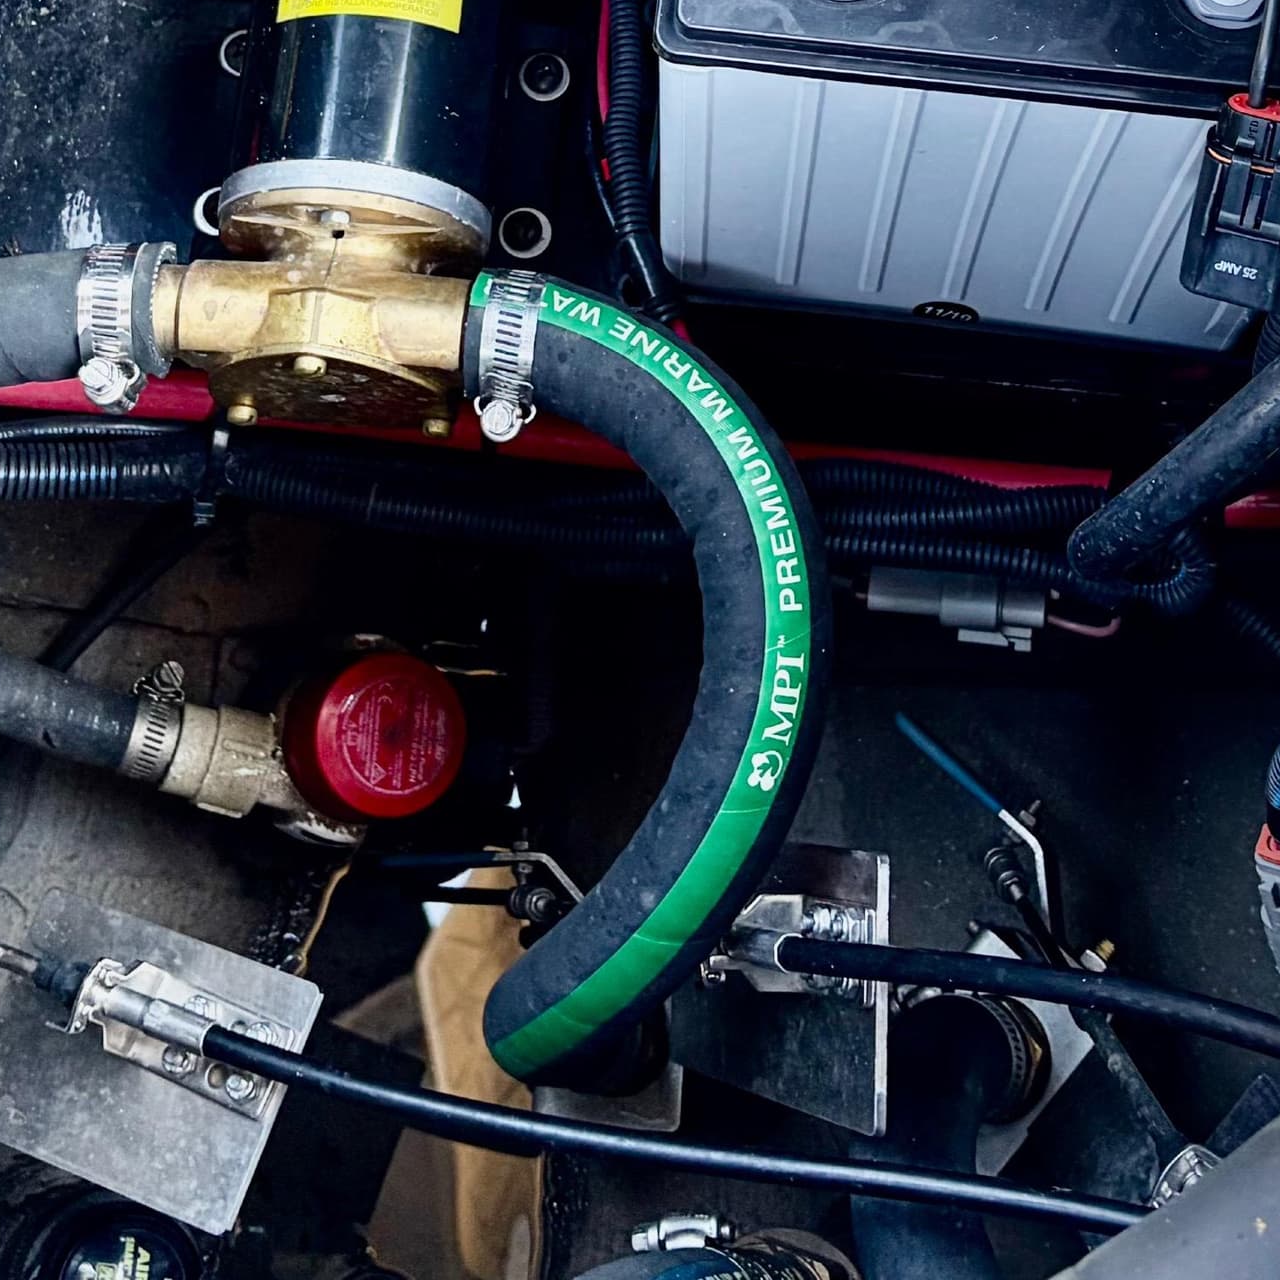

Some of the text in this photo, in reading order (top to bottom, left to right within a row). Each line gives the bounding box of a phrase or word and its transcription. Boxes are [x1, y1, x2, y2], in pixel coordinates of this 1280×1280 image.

[1213, 259, 1257, 280] 25 AMP
[608, 316, 735, 422] MARINE
[726, 425, 804, 613] PREMIUM
